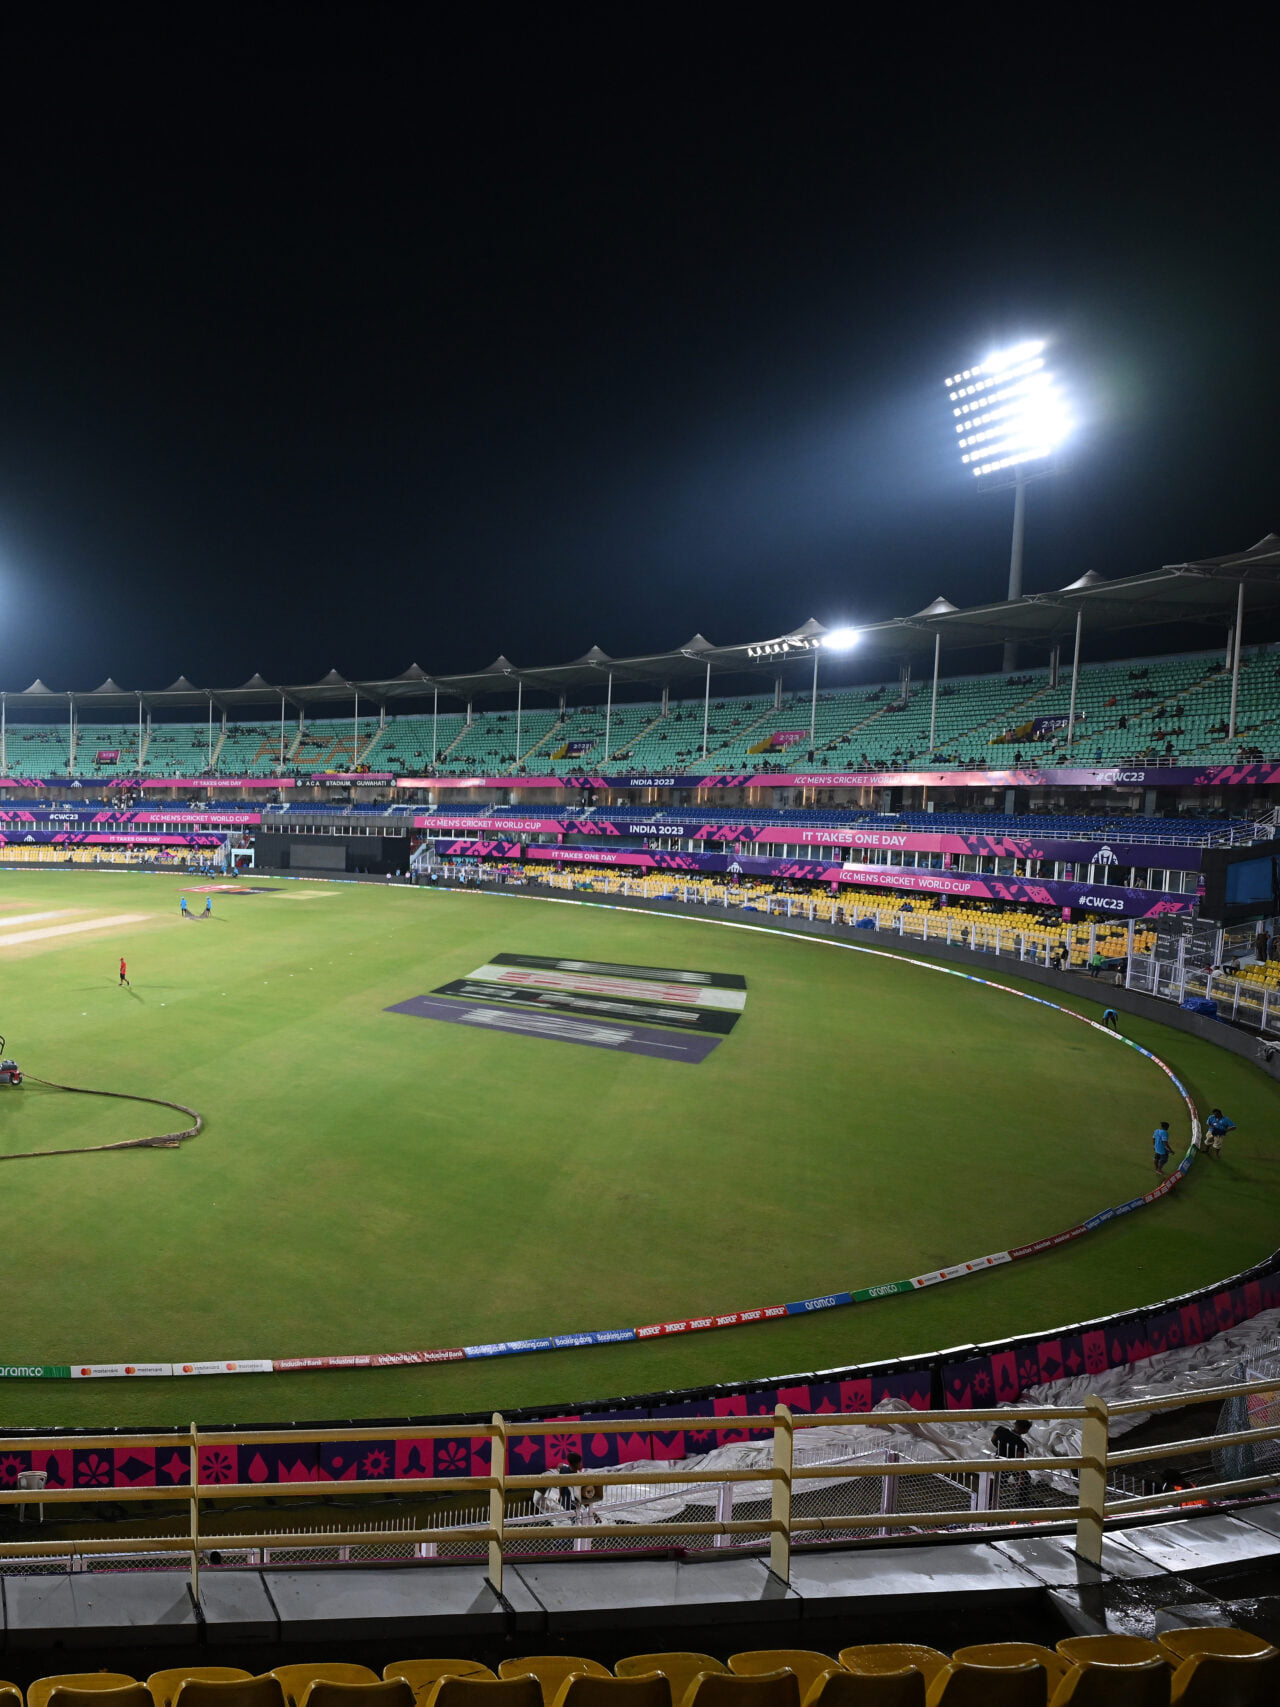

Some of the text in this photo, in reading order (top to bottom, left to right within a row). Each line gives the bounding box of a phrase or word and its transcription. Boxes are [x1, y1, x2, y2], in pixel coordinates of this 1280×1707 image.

[808, 776, 832, 784] MEN'S
[833, 776, 868, 784] CRICKET
[1096, 772, 1145, 782] #CWC23
[436, 819, 460, 827] MEN'S
[461, 820, 492, 828] CRICKET
[494, 820, 522, 829] WORLD
[524, 821, 541, 830] CUP
[629, 824, 684, 835] INDIA 2023
[802, 832, 907, 846] IT TAKES ONE DAY
[560, 852, 582, 860] TAKES
[601, 854, 617, 862] DAY
[839, 871, 971, 892] ICC MEN'S CRICKET WORLD CUP
[1079, 896, 1124, 910] #CWC23
[869, 1285, 898, 1297] aramco
[805, 1297, 836, 1310] aramco
[638, 1307, 785, 1337] MRF MRF MRF MRF MRF MRF
[596, 1331, 633, 1341] Booking.com
[449, 1350, 463, 1358] Bank
